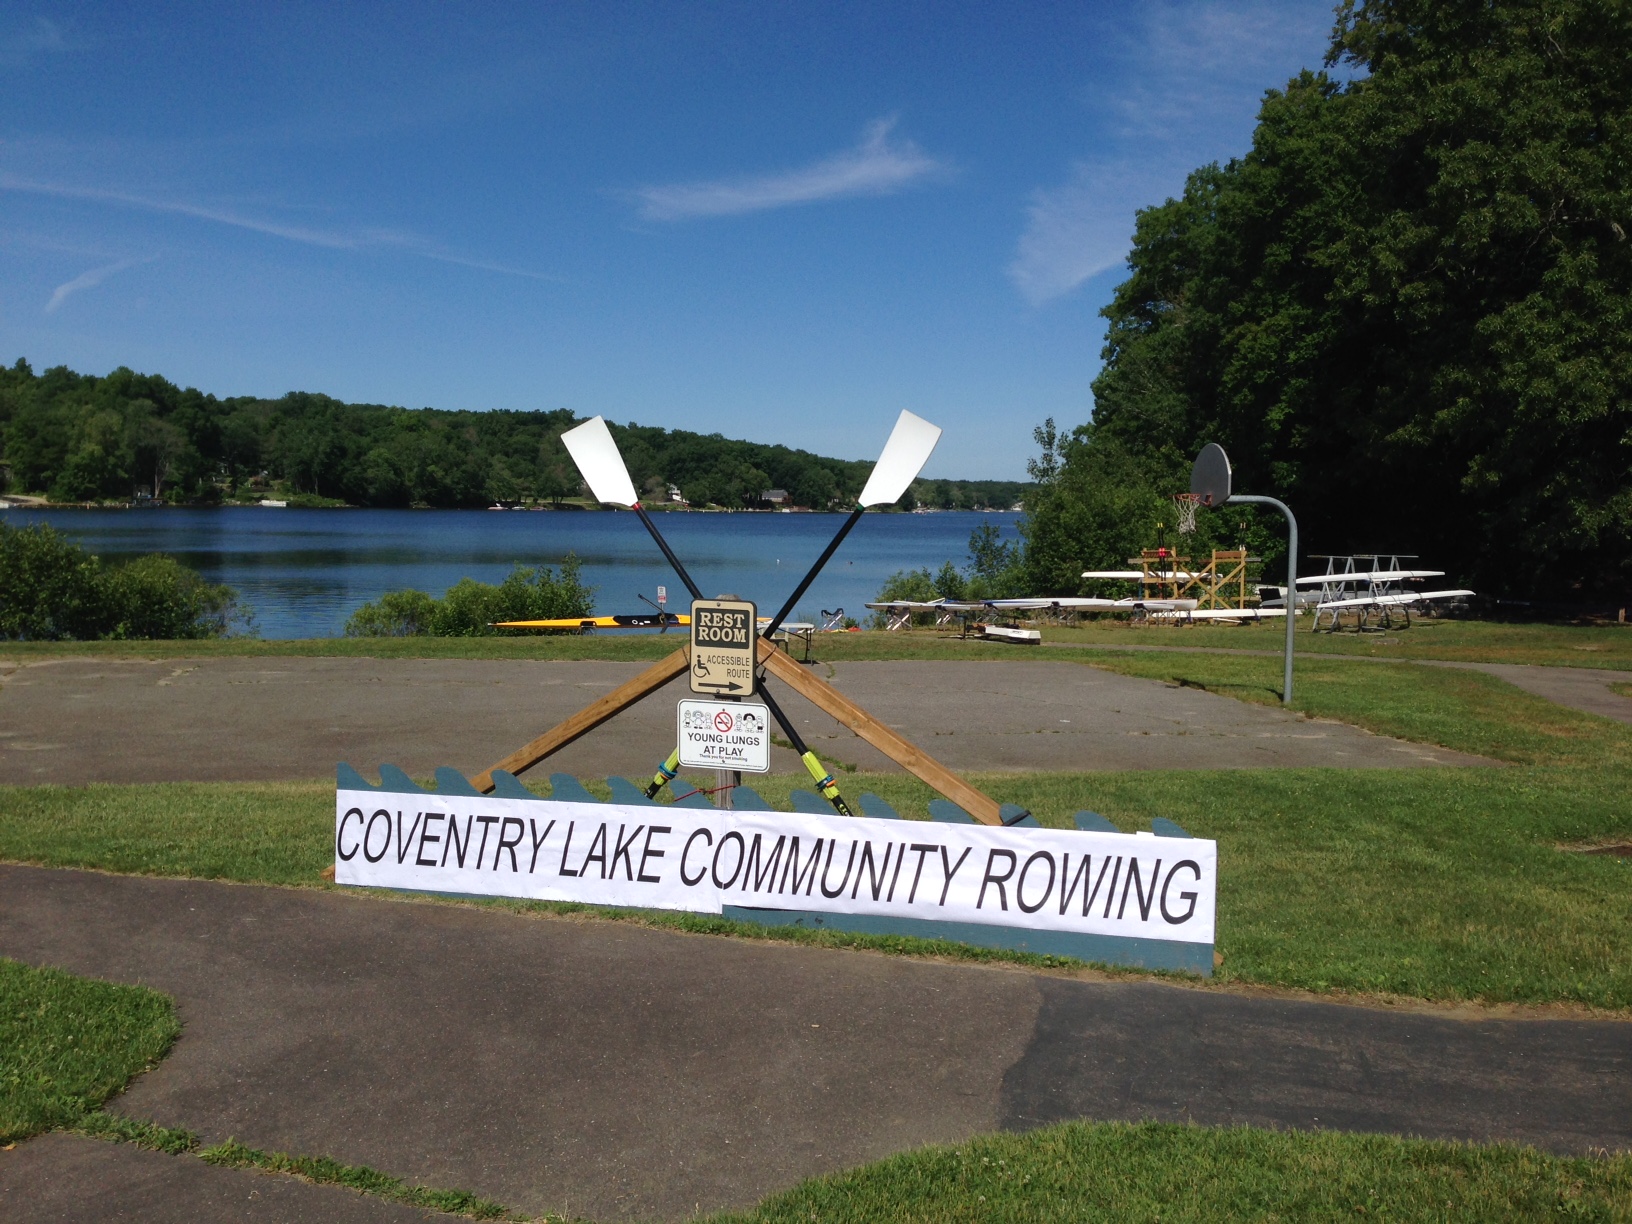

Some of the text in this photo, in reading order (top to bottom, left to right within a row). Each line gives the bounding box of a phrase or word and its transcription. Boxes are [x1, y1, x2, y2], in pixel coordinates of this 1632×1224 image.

[700, 612, 744, 627] REST
[698, 627, 746, 642] ROOM
[707, 655, 749, 666] ACCESSIBLE
[727, 669, 749, 678] ROUTE
[688, 732, 760, 746] YOUNG LUNGS
[703, 746, 744, 756] AT PLAY
[337, 808, 1202, 924] COVENTRY LAKE COMMUNITY ROWING
